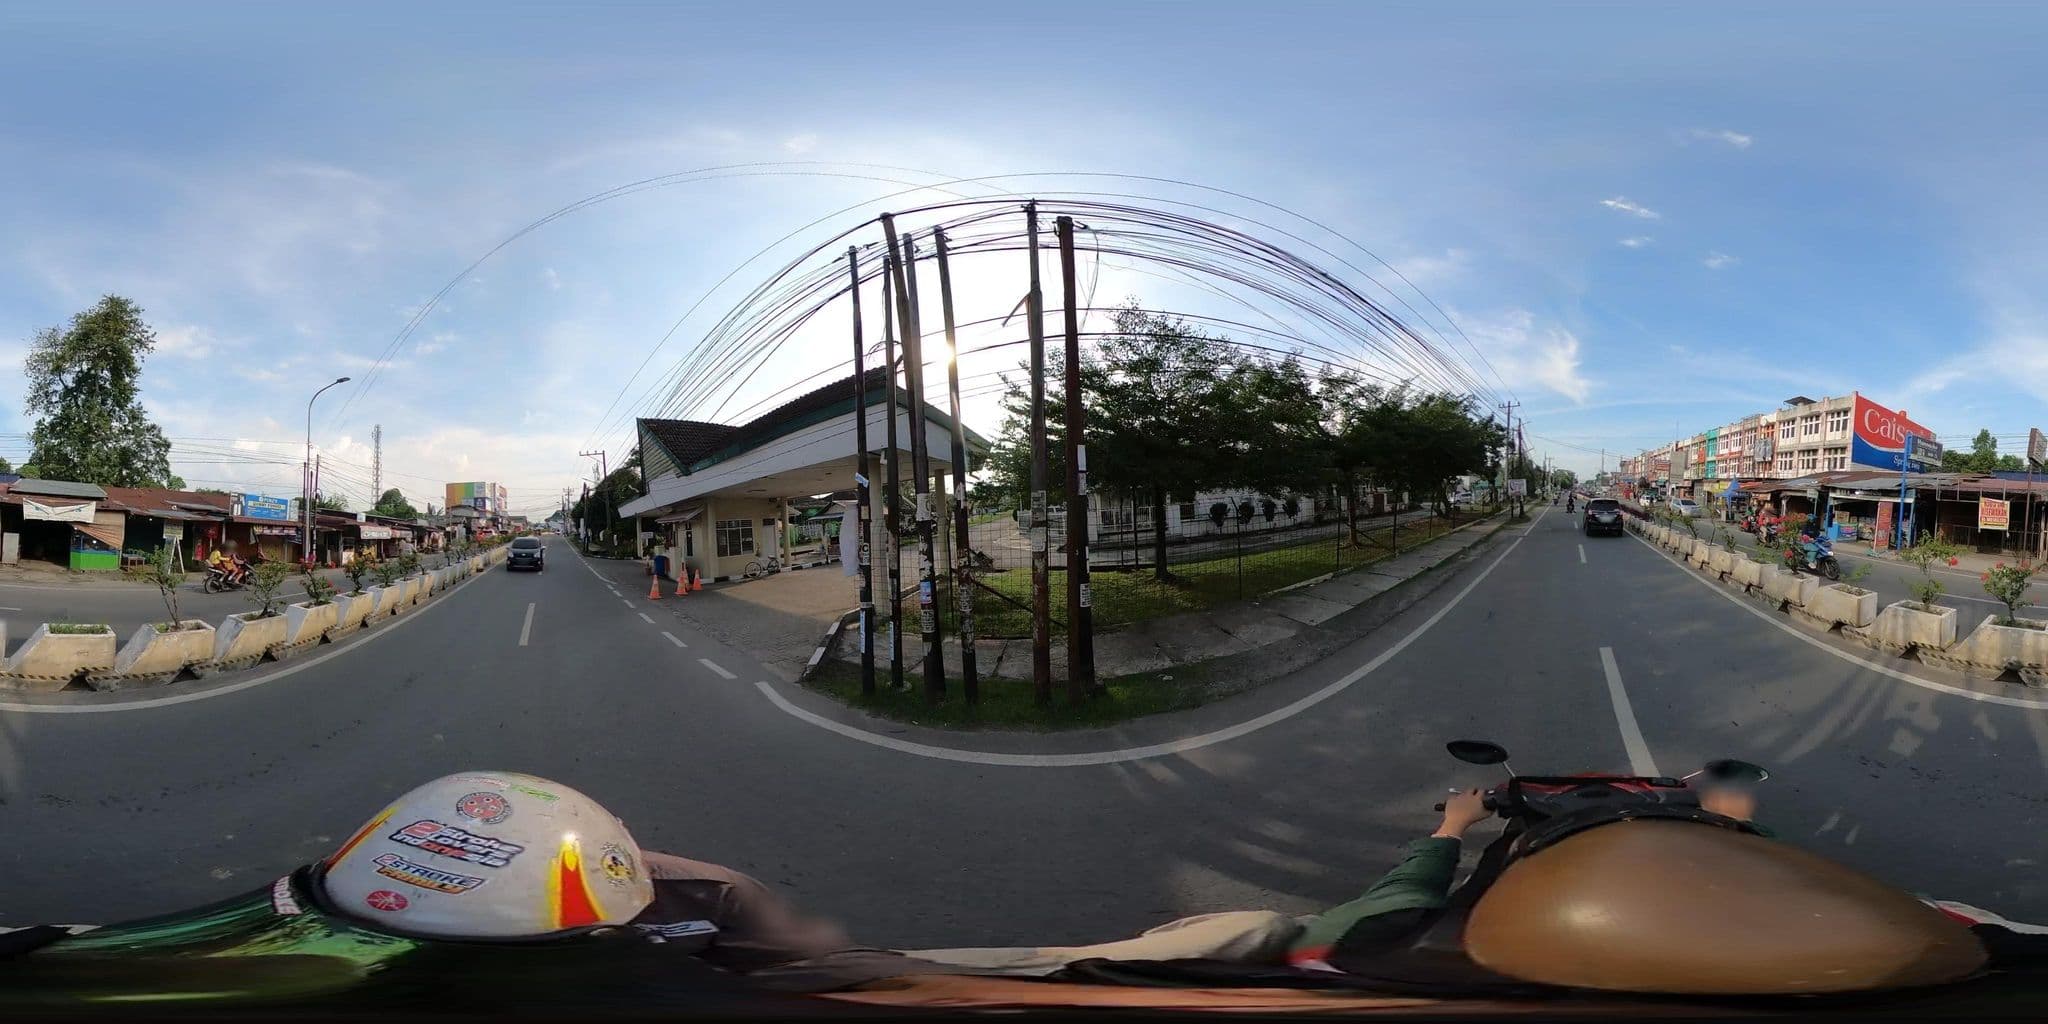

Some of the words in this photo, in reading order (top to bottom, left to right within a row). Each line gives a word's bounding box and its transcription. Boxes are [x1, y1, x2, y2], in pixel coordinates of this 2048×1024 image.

[403, 820, 445, 838] 2
[440, 827, 524, 854] Stroke
[426, 834, 515, 860] Lovers
